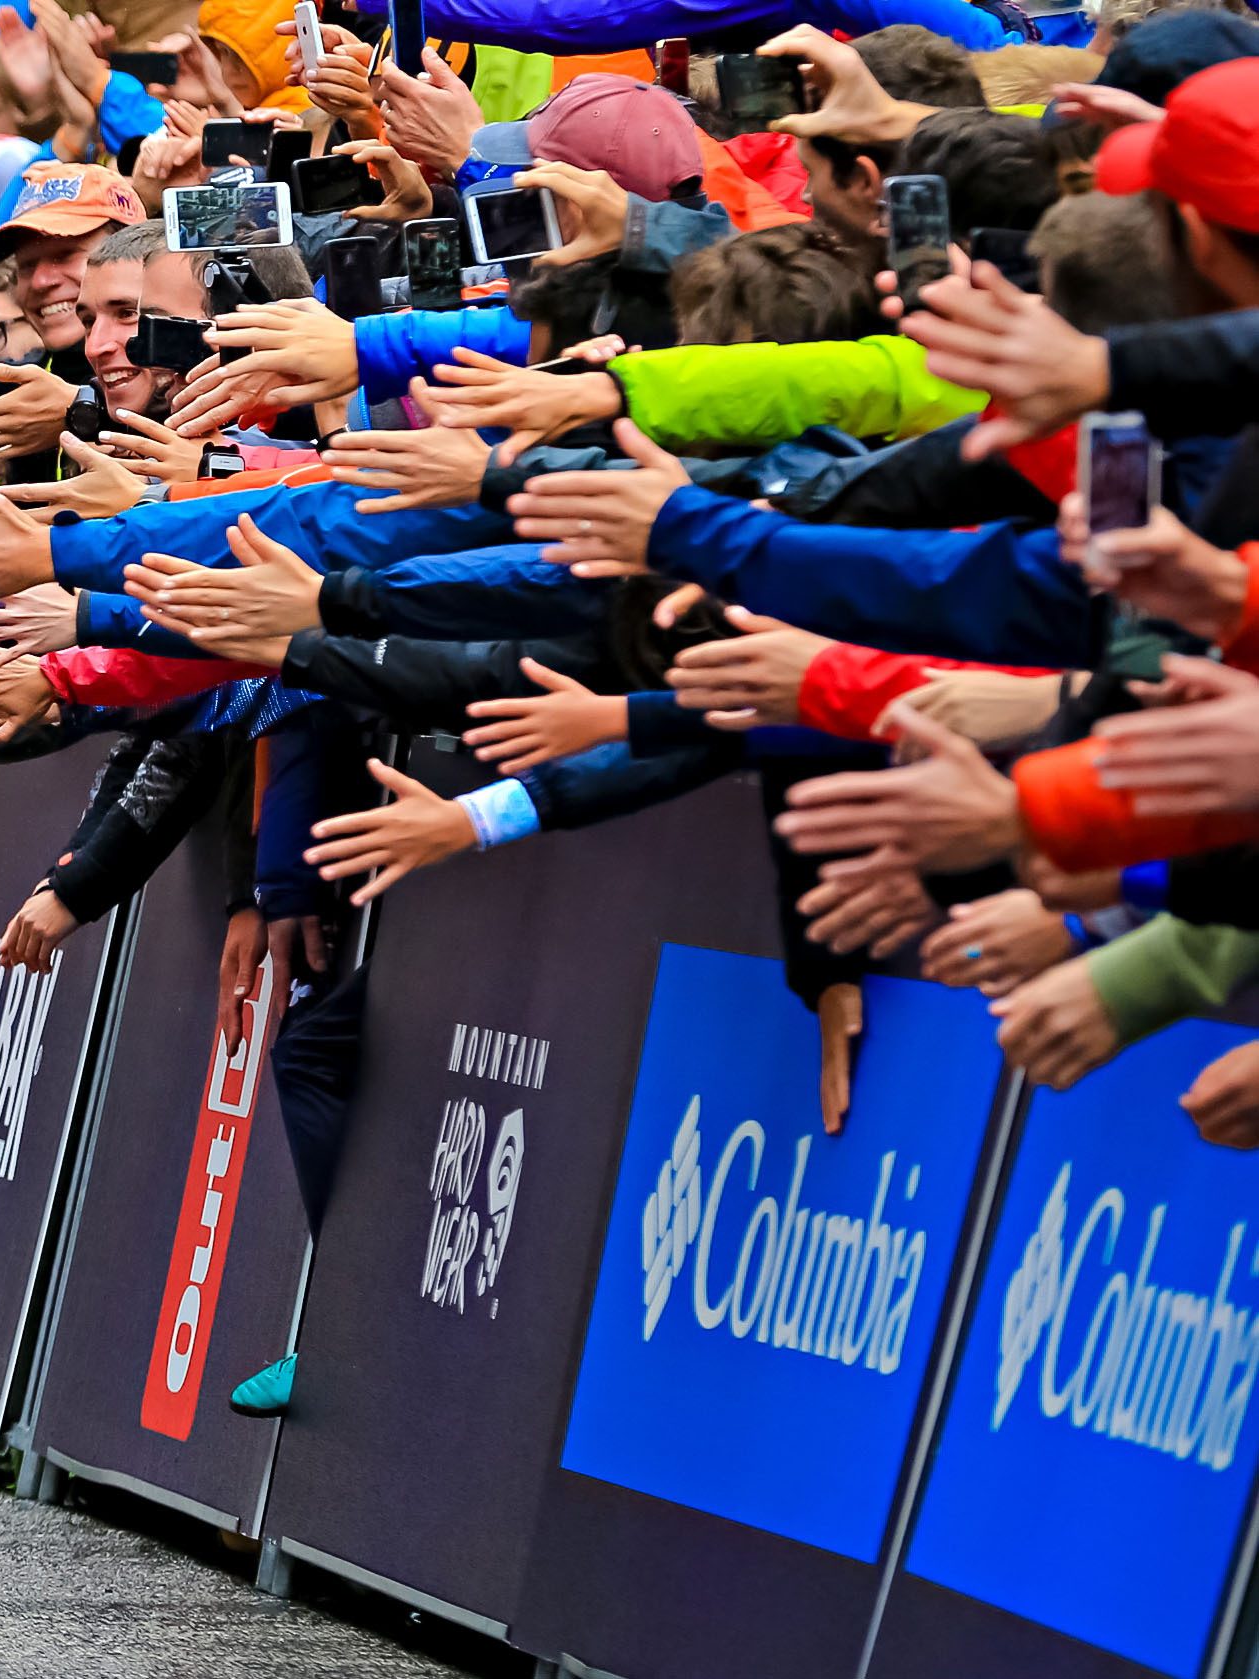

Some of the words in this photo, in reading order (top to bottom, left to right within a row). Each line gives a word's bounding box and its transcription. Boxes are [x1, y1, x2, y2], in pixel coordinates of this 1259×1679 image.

[448, 1023, 550, 1090] MOUNTAIN
[429, 1097, 486, 1205] HARD
[421, 1199, 480, 1315] WEAR
[694, 1119, 927, 1375] Columbia
[1041, 1187, 1259, 1473] Columbia
